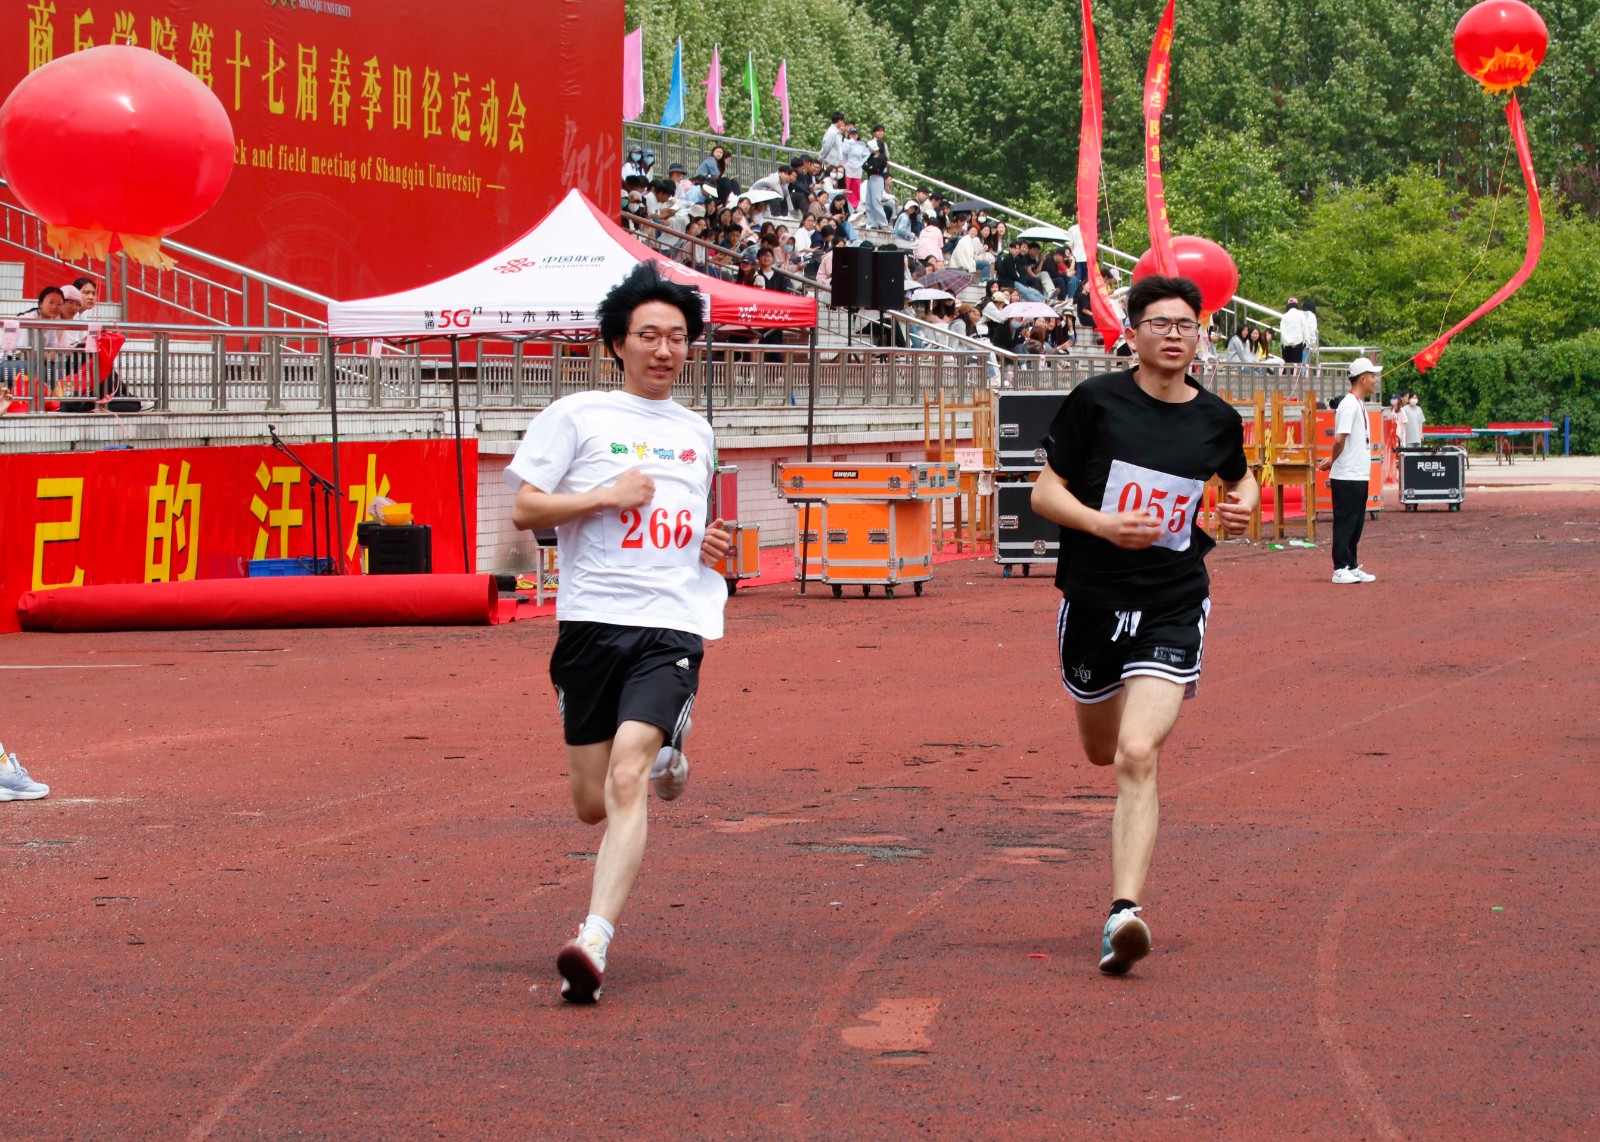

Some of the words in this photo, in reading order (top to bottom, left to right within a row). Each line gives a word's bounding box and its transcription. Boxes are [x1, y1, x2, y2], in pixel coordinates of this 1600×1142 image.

[323, 1, 352, 18] UNIVERSITY
[252, 143, 273, 169] and
[278, 145, 306, 172] field
[311, 153, 356, 183] meeting
[360, 156, 373, 180] of
[375, 157, 425, 190] Shangqiu
[429, 163, 482, 198] University
[620, 508, 693, 549] 266
[1118, 482, 1190, 533] 055
